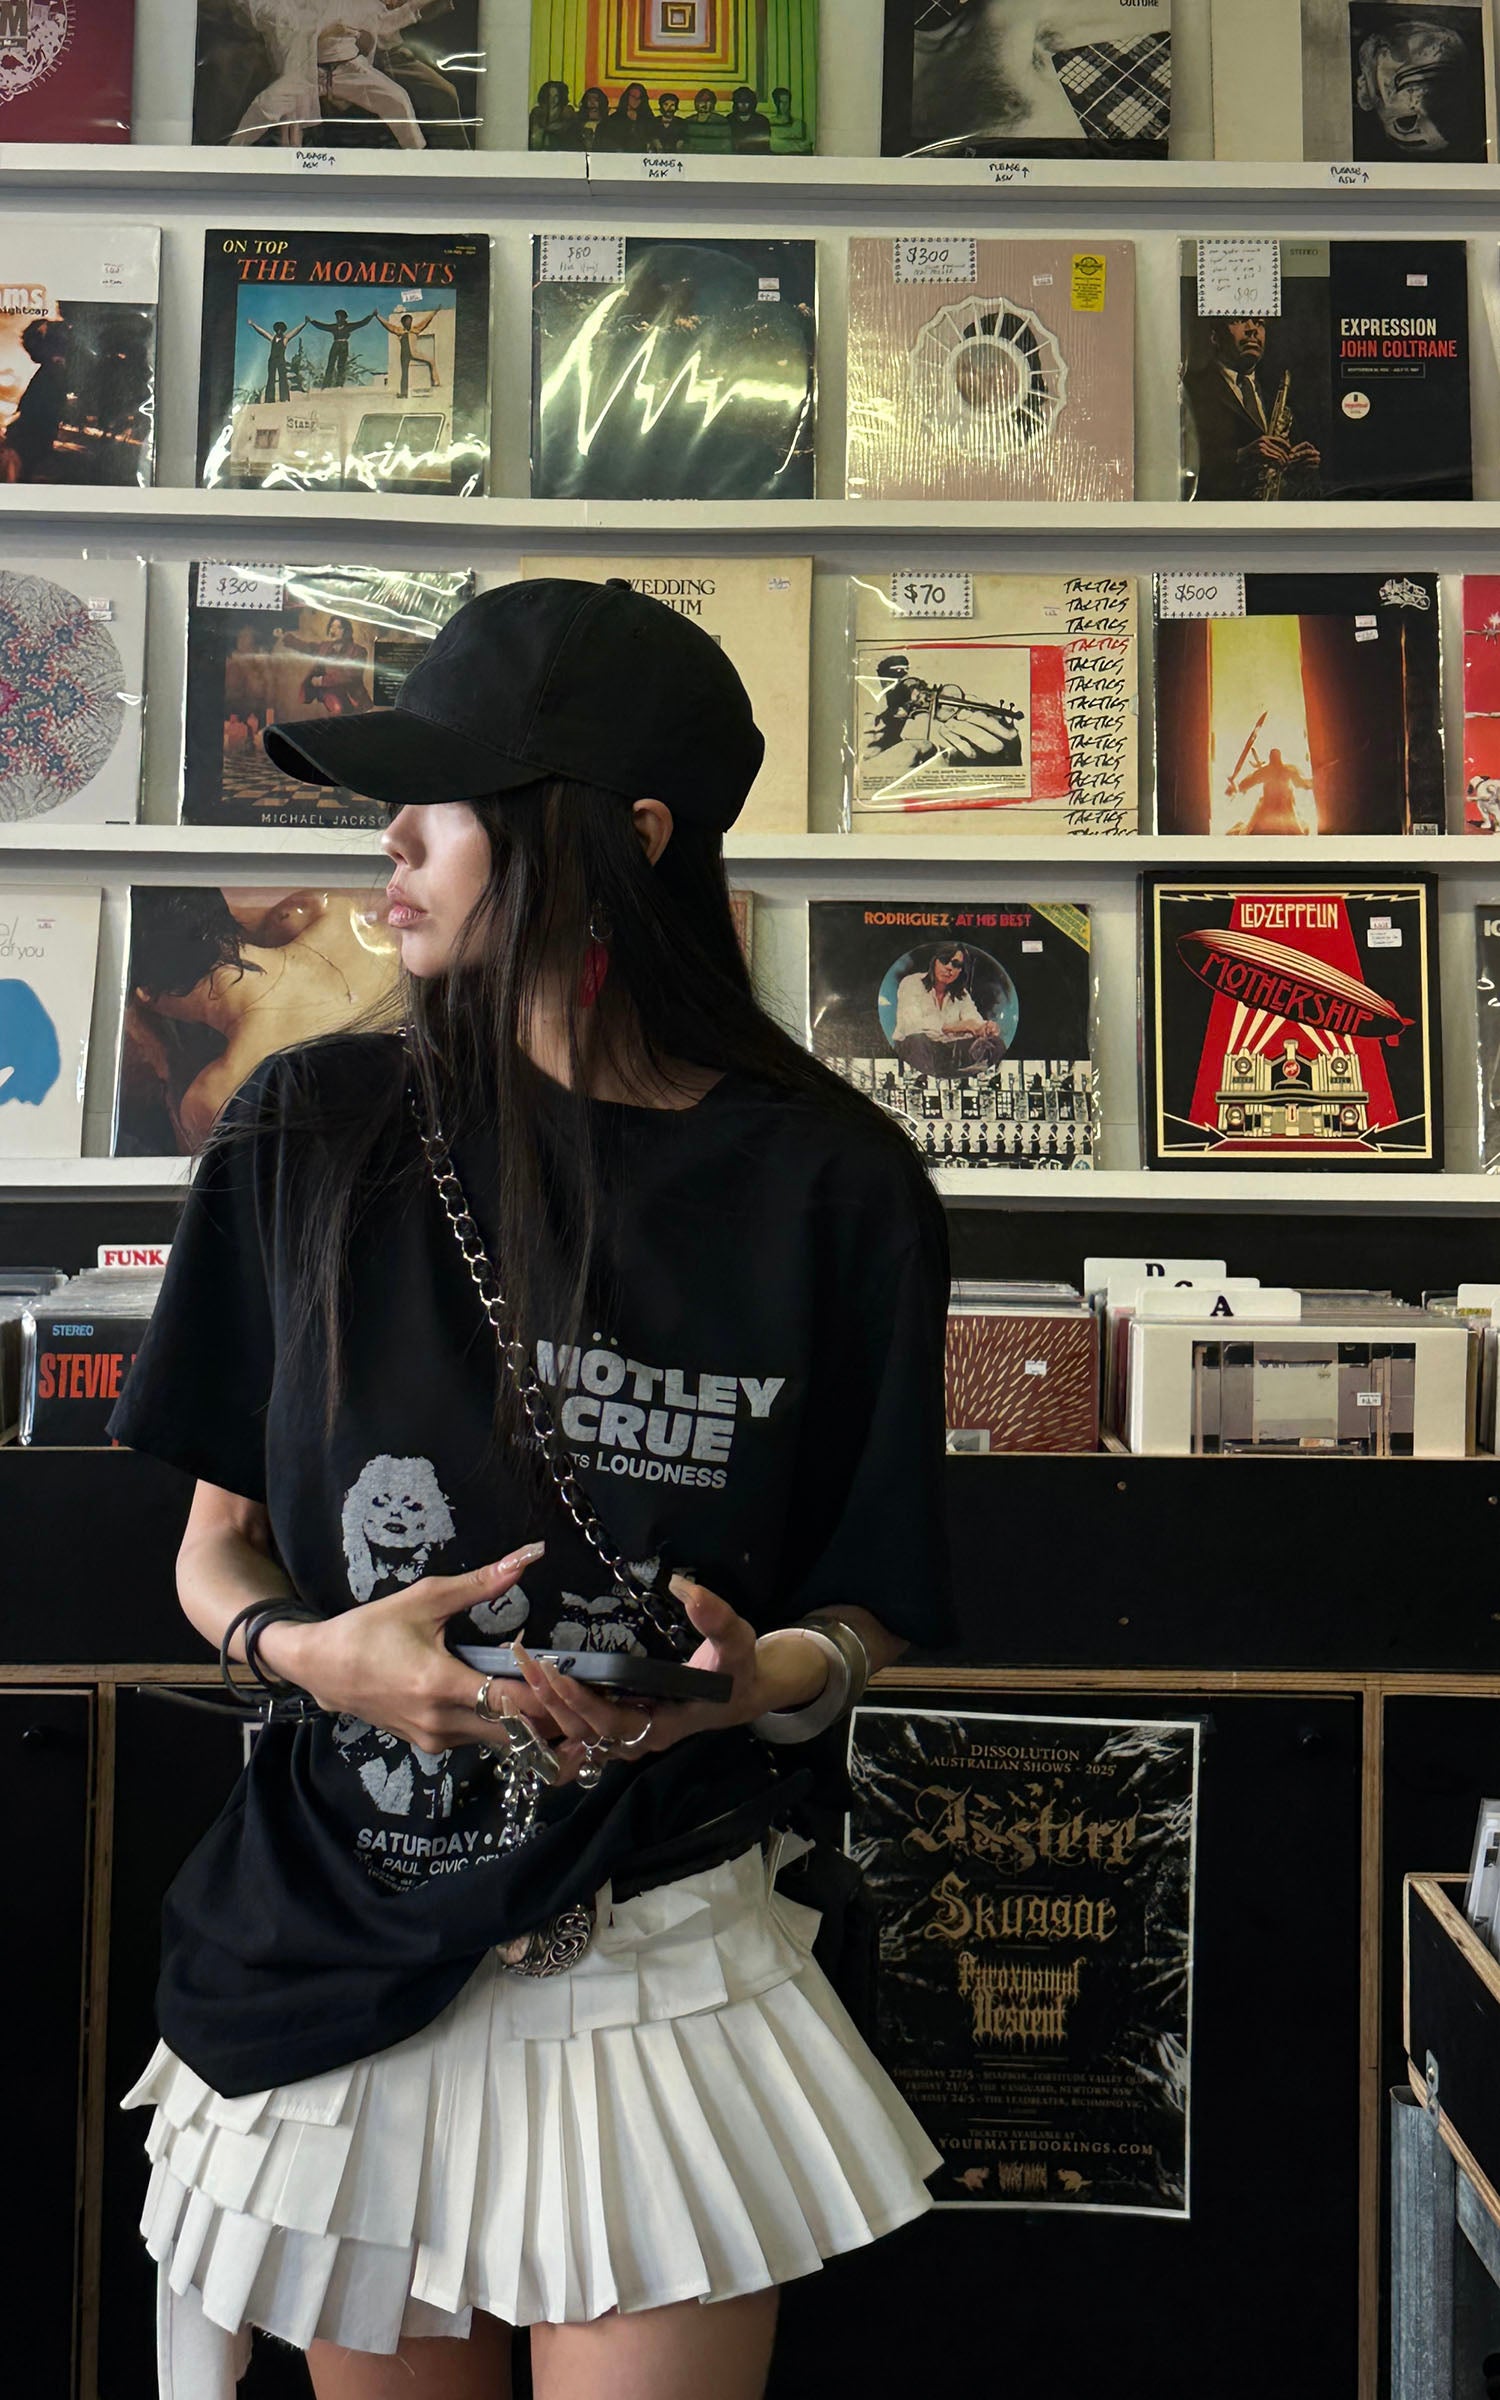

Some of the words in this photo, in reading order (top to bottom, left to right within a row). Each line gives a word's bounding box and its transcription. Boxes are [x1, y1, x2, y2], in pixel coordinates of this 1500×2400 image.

[223, 240, 248, 253] ON
[254, 240, 288, 255] TOP
[906, 246, 949, 265] $300
[237, 259, 297, 281] THE
[309, 261, 457, 284] MOMENTS
[1340, 318, 1438, 337] EXPRESSION
[1340, 340, 1380, 358] JOHN
[1382, 340, 1458, 358] COLTRANE
[216, 578, 258, 595] $300
[904, 583, 946, 605] $70
[1064, 578, 1128, 595] TACTICS
[1174, 584, 1218, 603] $500
[1065, 597, 1129, 613] TACTICS
[1065, 616, 1128, 633] TACTICS
[1065, 637, 1129, 655] TACTICS
[1065, 656, 1124, 675] TACTICS
[1066, 676, 1125, 695] TACTICS
[1067, 696, 1129, 712] TACTICS
[1067, 715, 1125, 732] TACTICS
[1068, 734, 1128, 753] TACTICS
[1065, 752, 1125, 771] TACTICS
[1064, 770, 1124, 790] TACTICS
[1063, 788, 1125, 808] TACTICS
[261, 813, 325, 825] MICHAEL
[332, 815, 387, 826] JACKSO
[1063, 810, 1128, 829] TACTICS
[864, 911, 949, 927] RODRIGUEZ
[955, 913, 974, 927] AT
[976, 913, 997, 927] HIS
[1000, 914, 1032, 928] BEST
[1201, 953, 1374, 1034] MOTHERSHIP
[104, 1250, 165, 1266] FUNK
[1209, 1295, 1234, 1317] A
[52, 1325, 94, 1336] STEREO
[38, 1352, 124, 1399] STEVIE
[561, 1395, 735, 1463] CRUE
[596, 1451, 728, 1489] LOUDNESS
[971, 1744, 1080, 1761] DISSOLUTION
[930, 1756, 1019, 1771] AUSTRALIAN
[1023, 1761, 1071, 1773] SHOWS
[1085, 1764, 1116, 1777] 2025
[356, 1828, 479, 1857] SATURDAY
[382, 1858, 422, 1875] PAUL
[429, 1858, 469, 1875] CIVIC
[938, 2138, 1153, 2155] YOURMATEBOOKINGS.COM
